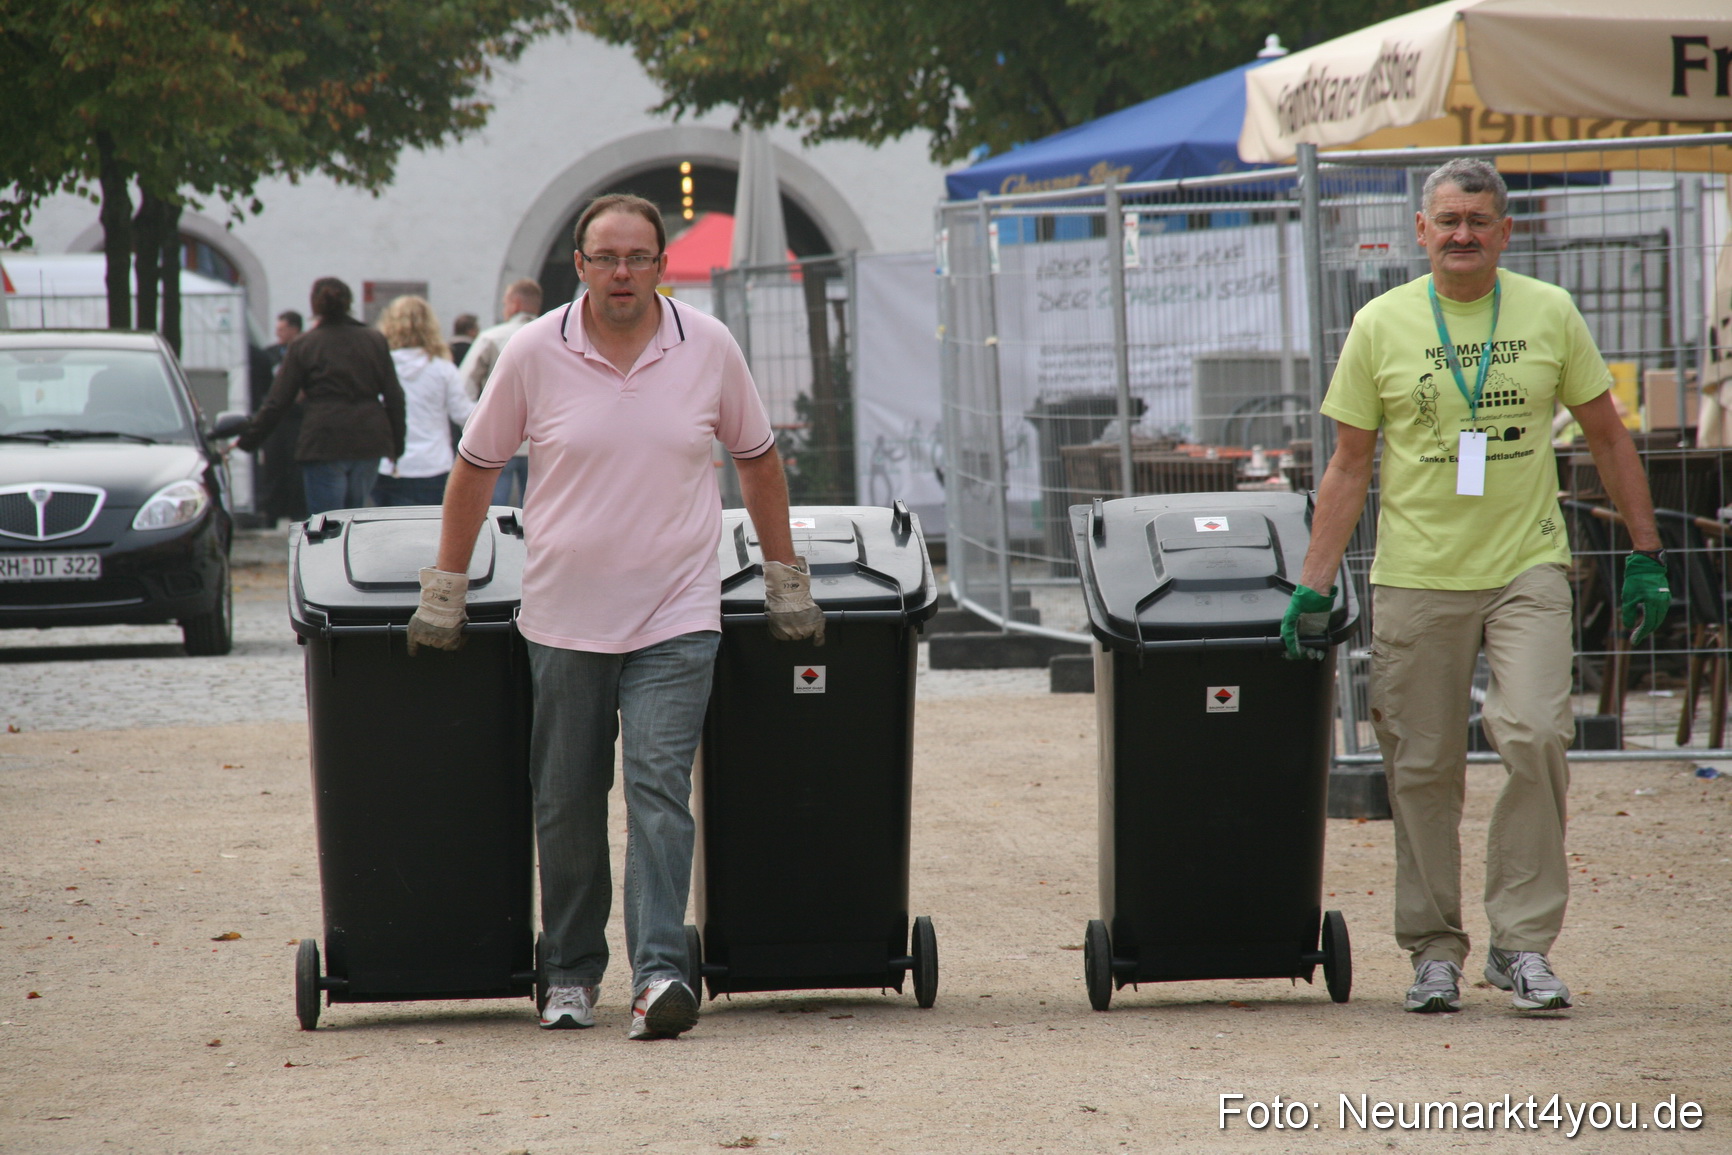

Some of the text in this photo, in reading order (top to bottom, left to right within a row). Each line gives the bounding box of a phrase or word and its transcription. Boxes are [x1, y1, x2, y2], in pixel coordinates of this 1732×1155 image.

[1278, 66, 1365, 138] Franiskaner
[1425, 339, 1527, 360] NEMAKTER
[1434, 352, 1520, 370] STDTAUF
[1419, 455, 1446, 463] Danke
[1485, 449, 1535, 462] adtlaufteam
[33, 558, 57, 576] DT
[63, 557, 98, 575] 322
